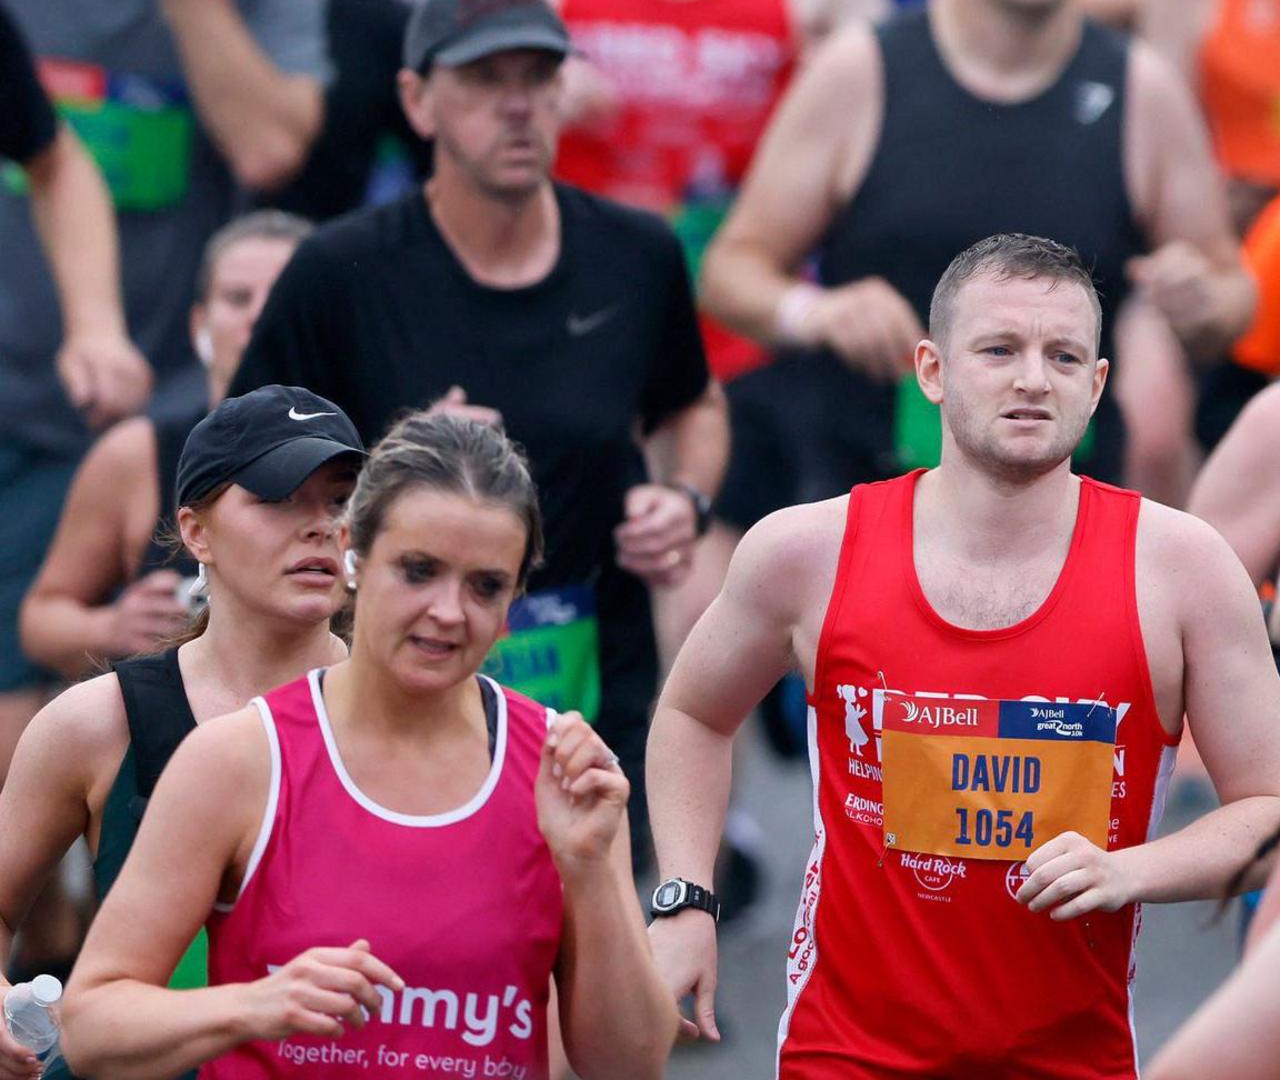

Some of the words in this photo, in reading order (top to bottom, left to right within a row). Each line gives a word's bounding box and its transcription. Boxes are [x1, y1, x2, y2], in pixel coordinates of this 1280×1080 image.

[918, 706, 978, 728] AJBell
[1037, 722, 1057, 730] great
[1038, 710, 1064, 719] AJBell
[952, 753, 1041, 793] DAVID
[955, 808, 1034, 848] 1054
[901, 854, 932, 871] Hard
[934, 858, 966, 878] Rock
[917, 893, 951, 903] NEWCASTLE
[277, 1040, 369, 1069] Together,
[377, 1044, 408, 1067] for
[415, 1054, 477, 1078] every
